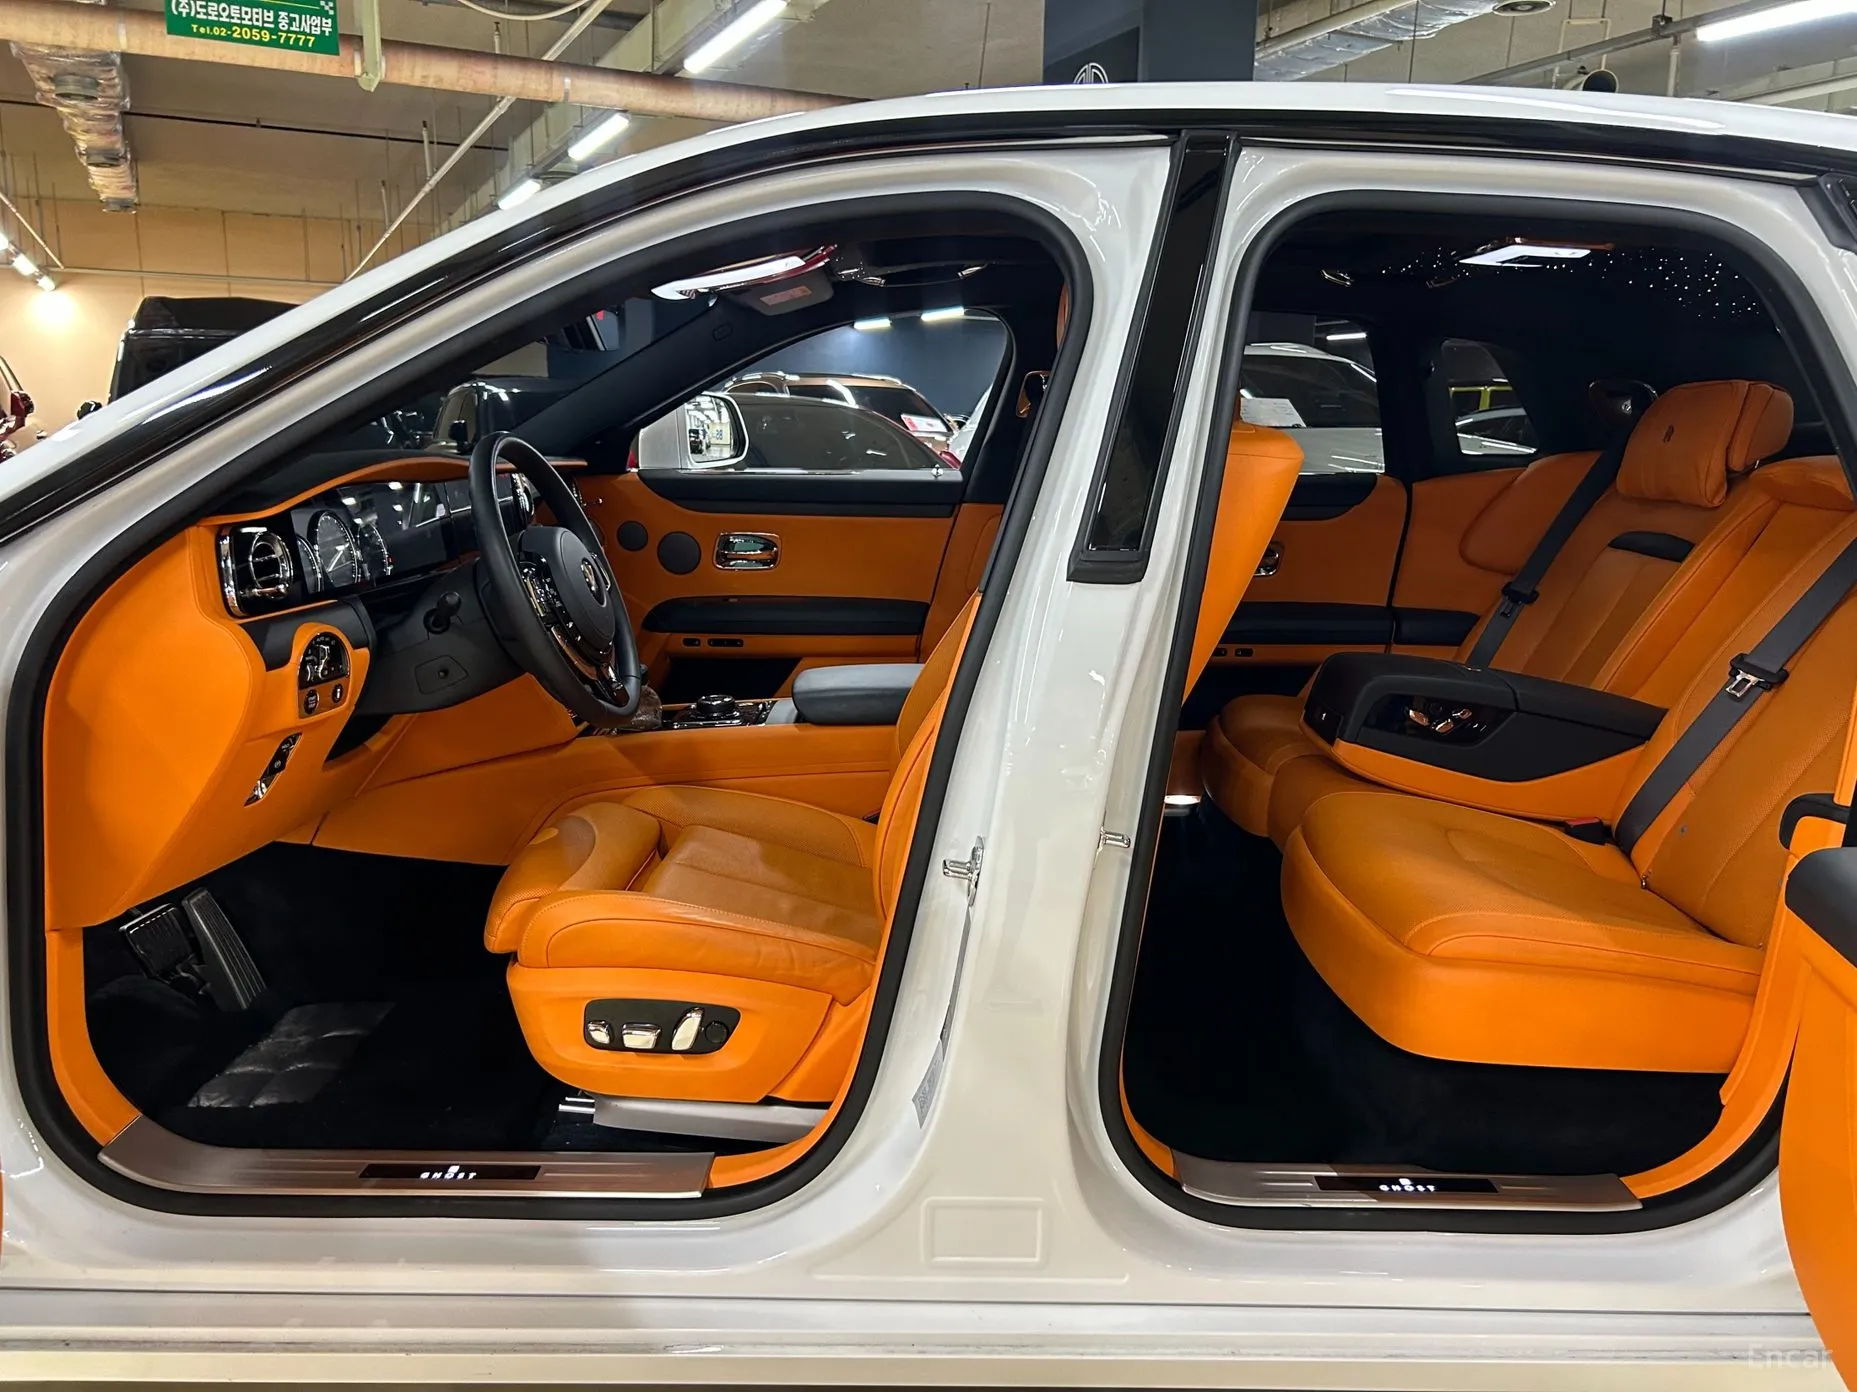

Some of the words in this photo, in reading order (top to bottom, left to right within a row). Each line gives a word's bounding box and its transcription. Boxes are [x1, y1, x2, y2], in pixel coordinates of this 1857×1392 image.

[278, 11, 332, 36] 중고사업부
[191, 24, 315, 47] Tel.02-2059-7777
[420, 1172, 476, 1180] GHOST
[1379, 1184, 1436, 1192] GHOST
